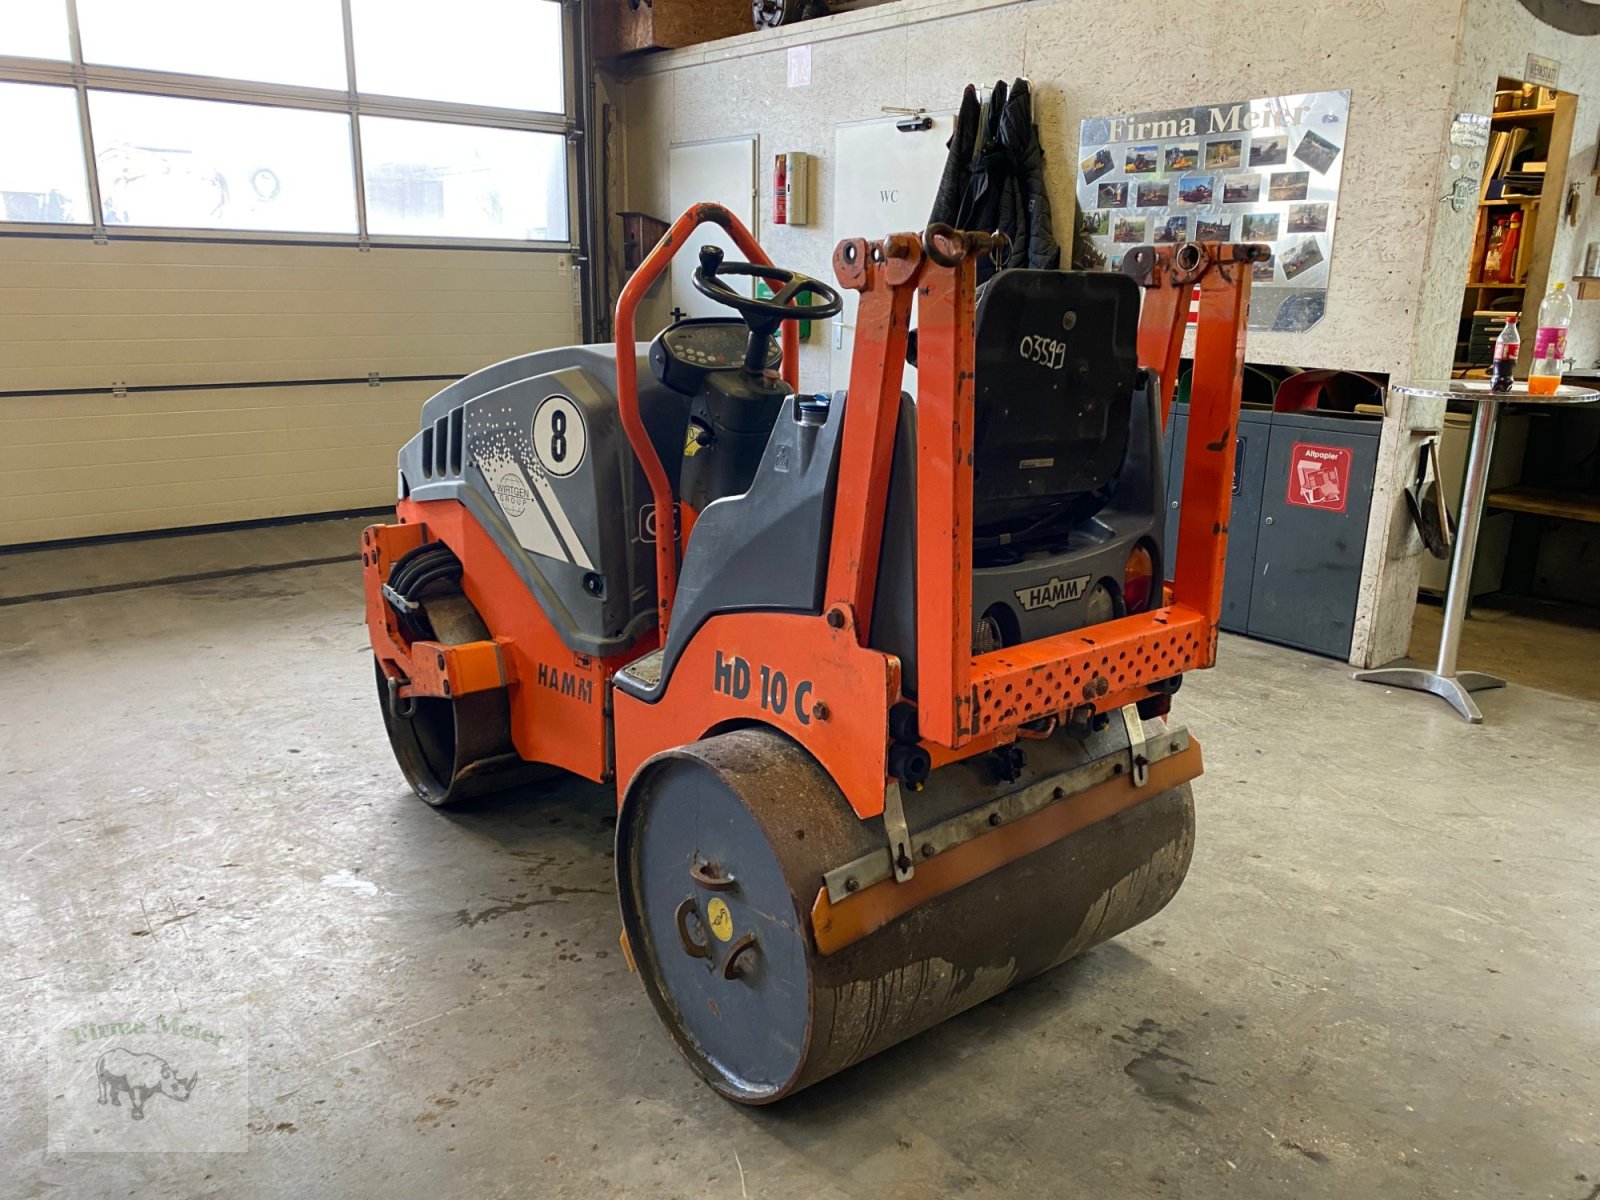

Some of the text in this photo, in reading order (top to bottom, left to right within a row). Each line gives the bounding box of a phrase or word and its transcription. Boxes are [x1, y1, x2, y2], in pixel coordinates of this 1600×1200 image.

[1107, 117, 1196, 143] Firma
[880, 190, 899, 203] WC
[551, 409, 567, 463] 8
[1305, 449, 1339, 460] Altpapier
[497, 483, 529, 498] WIRTGEN
[500, 495, 527, 506] GROUP
[1030, 581, 1078, 606] HAMM
[714, 650, 813, 725] HD 10 C
